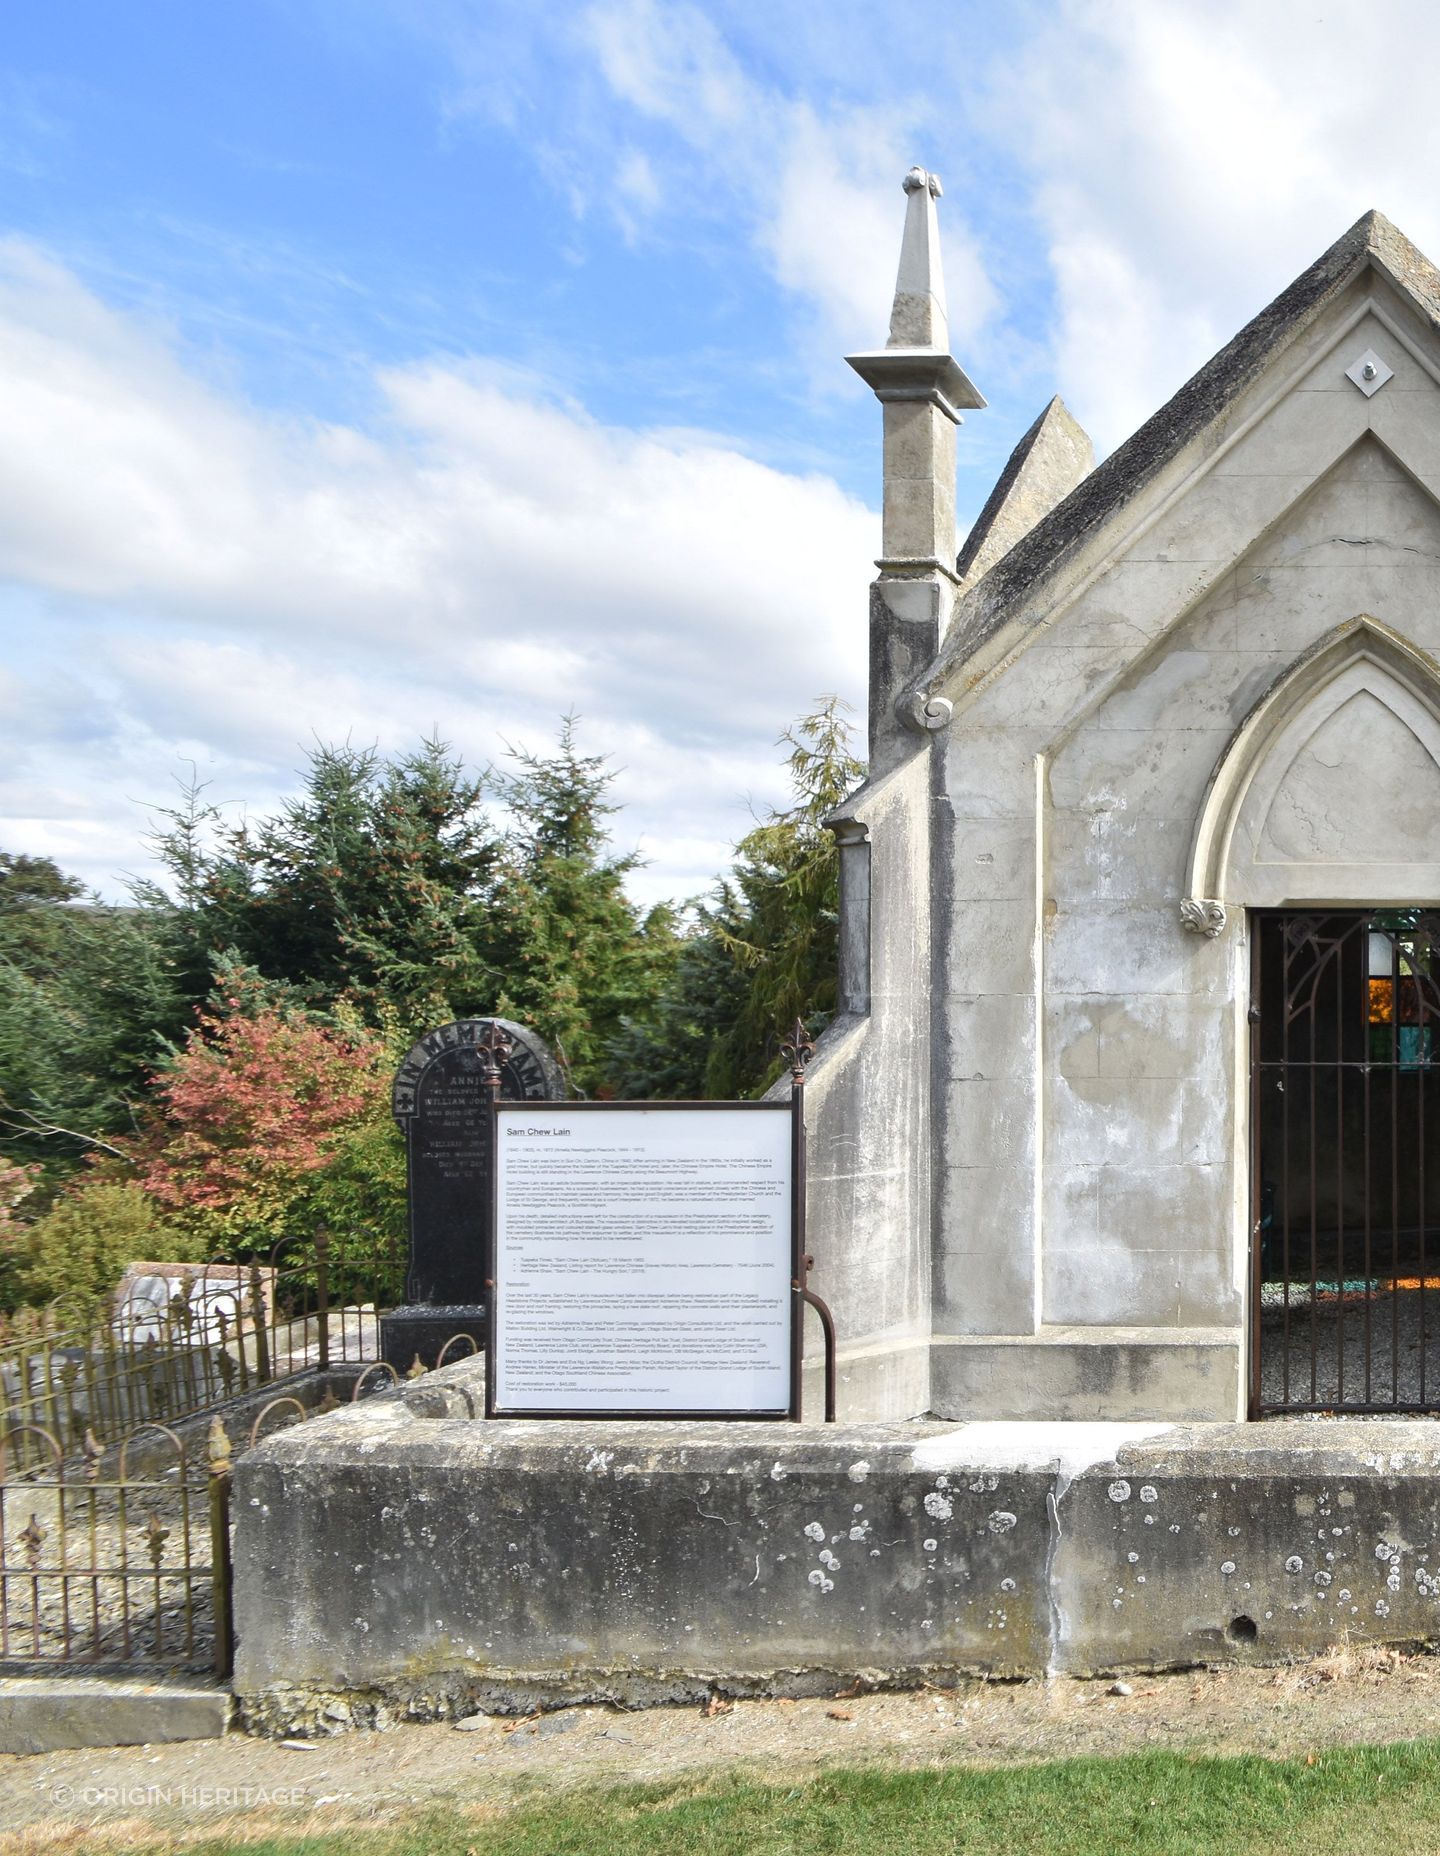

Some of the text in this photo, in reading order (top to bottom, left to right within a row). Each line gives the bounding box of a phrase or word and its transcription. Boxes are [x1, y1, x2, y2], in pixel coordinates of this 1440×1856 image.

[398, 1063, 425, 1088] IN
[506, 1128, 570, 1136] Sam Chew Lain
